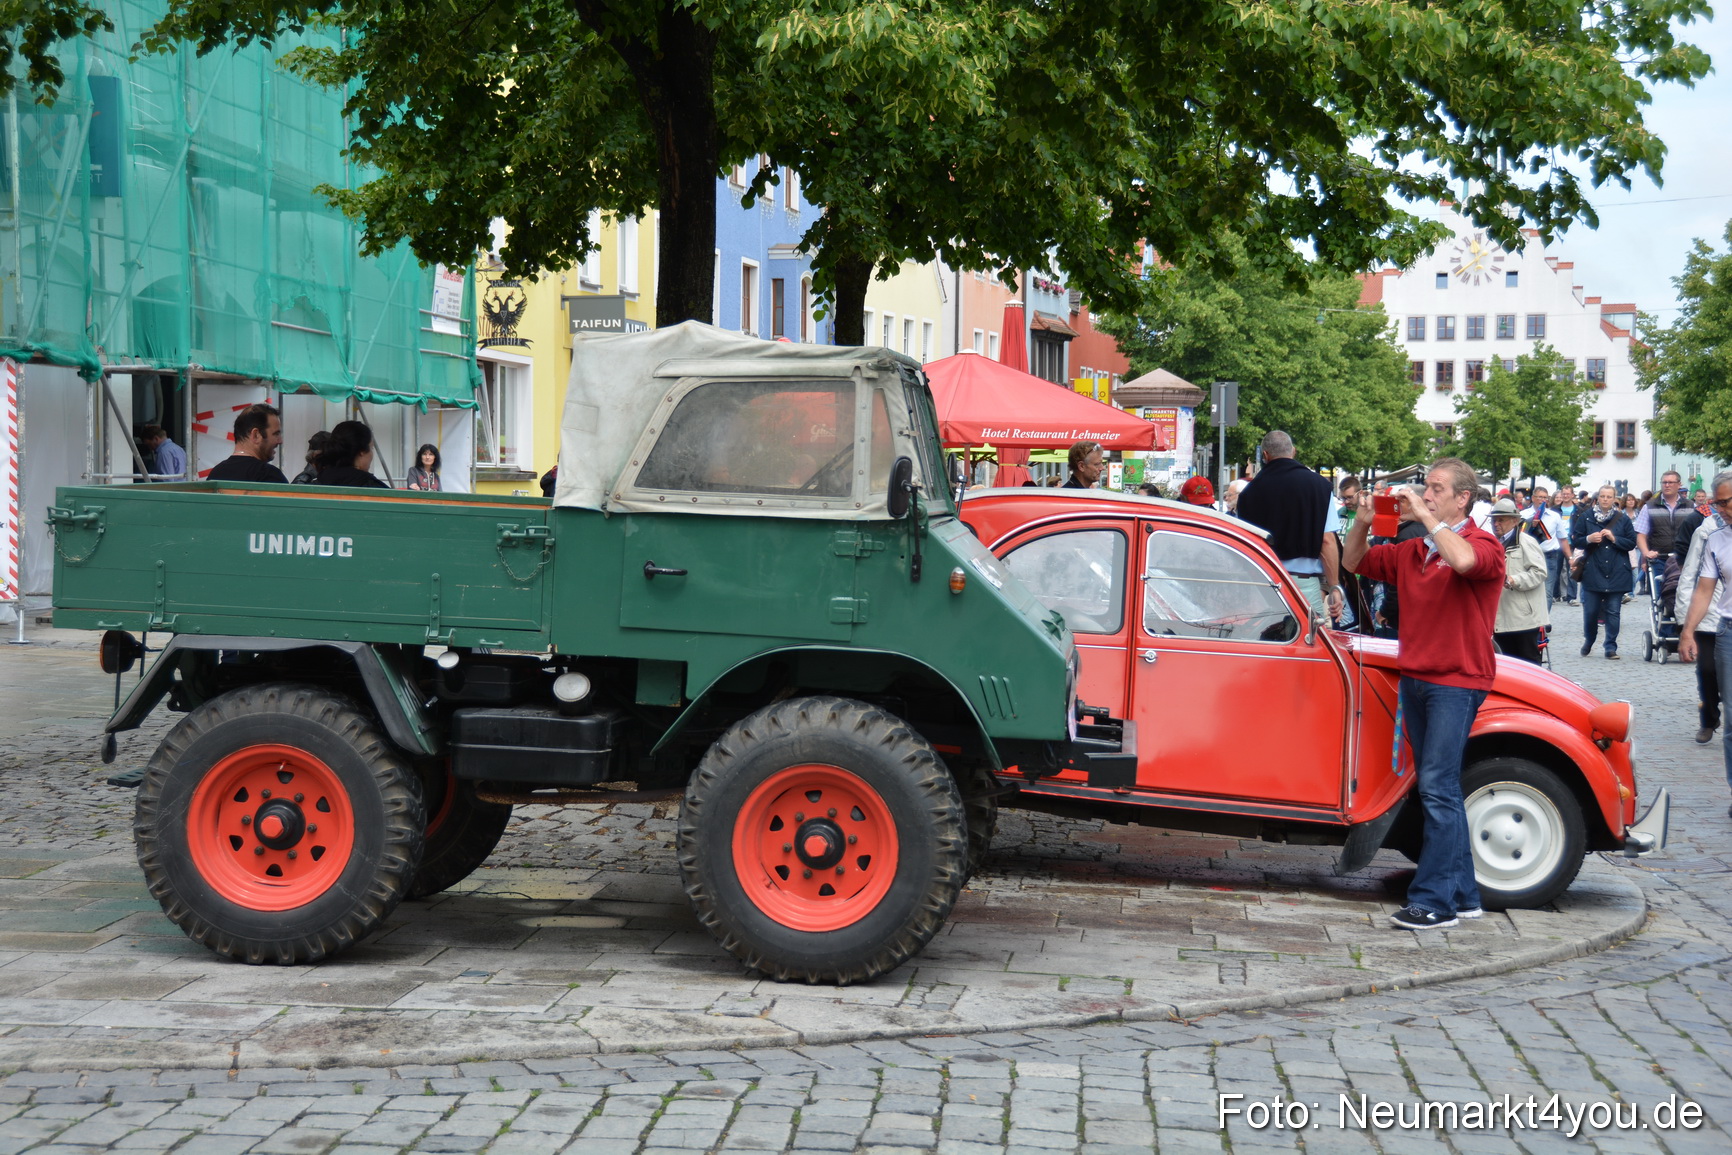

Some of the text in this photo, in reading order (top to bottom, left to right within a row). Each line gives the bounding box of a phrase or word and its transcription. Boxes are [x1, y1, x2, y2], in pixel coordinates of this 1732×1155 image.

[572, 319, 622, 329] TAIFUN
[981, 428, 1121, 441] Hotel Restaurant Lehmeier
[249, 533, 353, 557] UNIMOG
